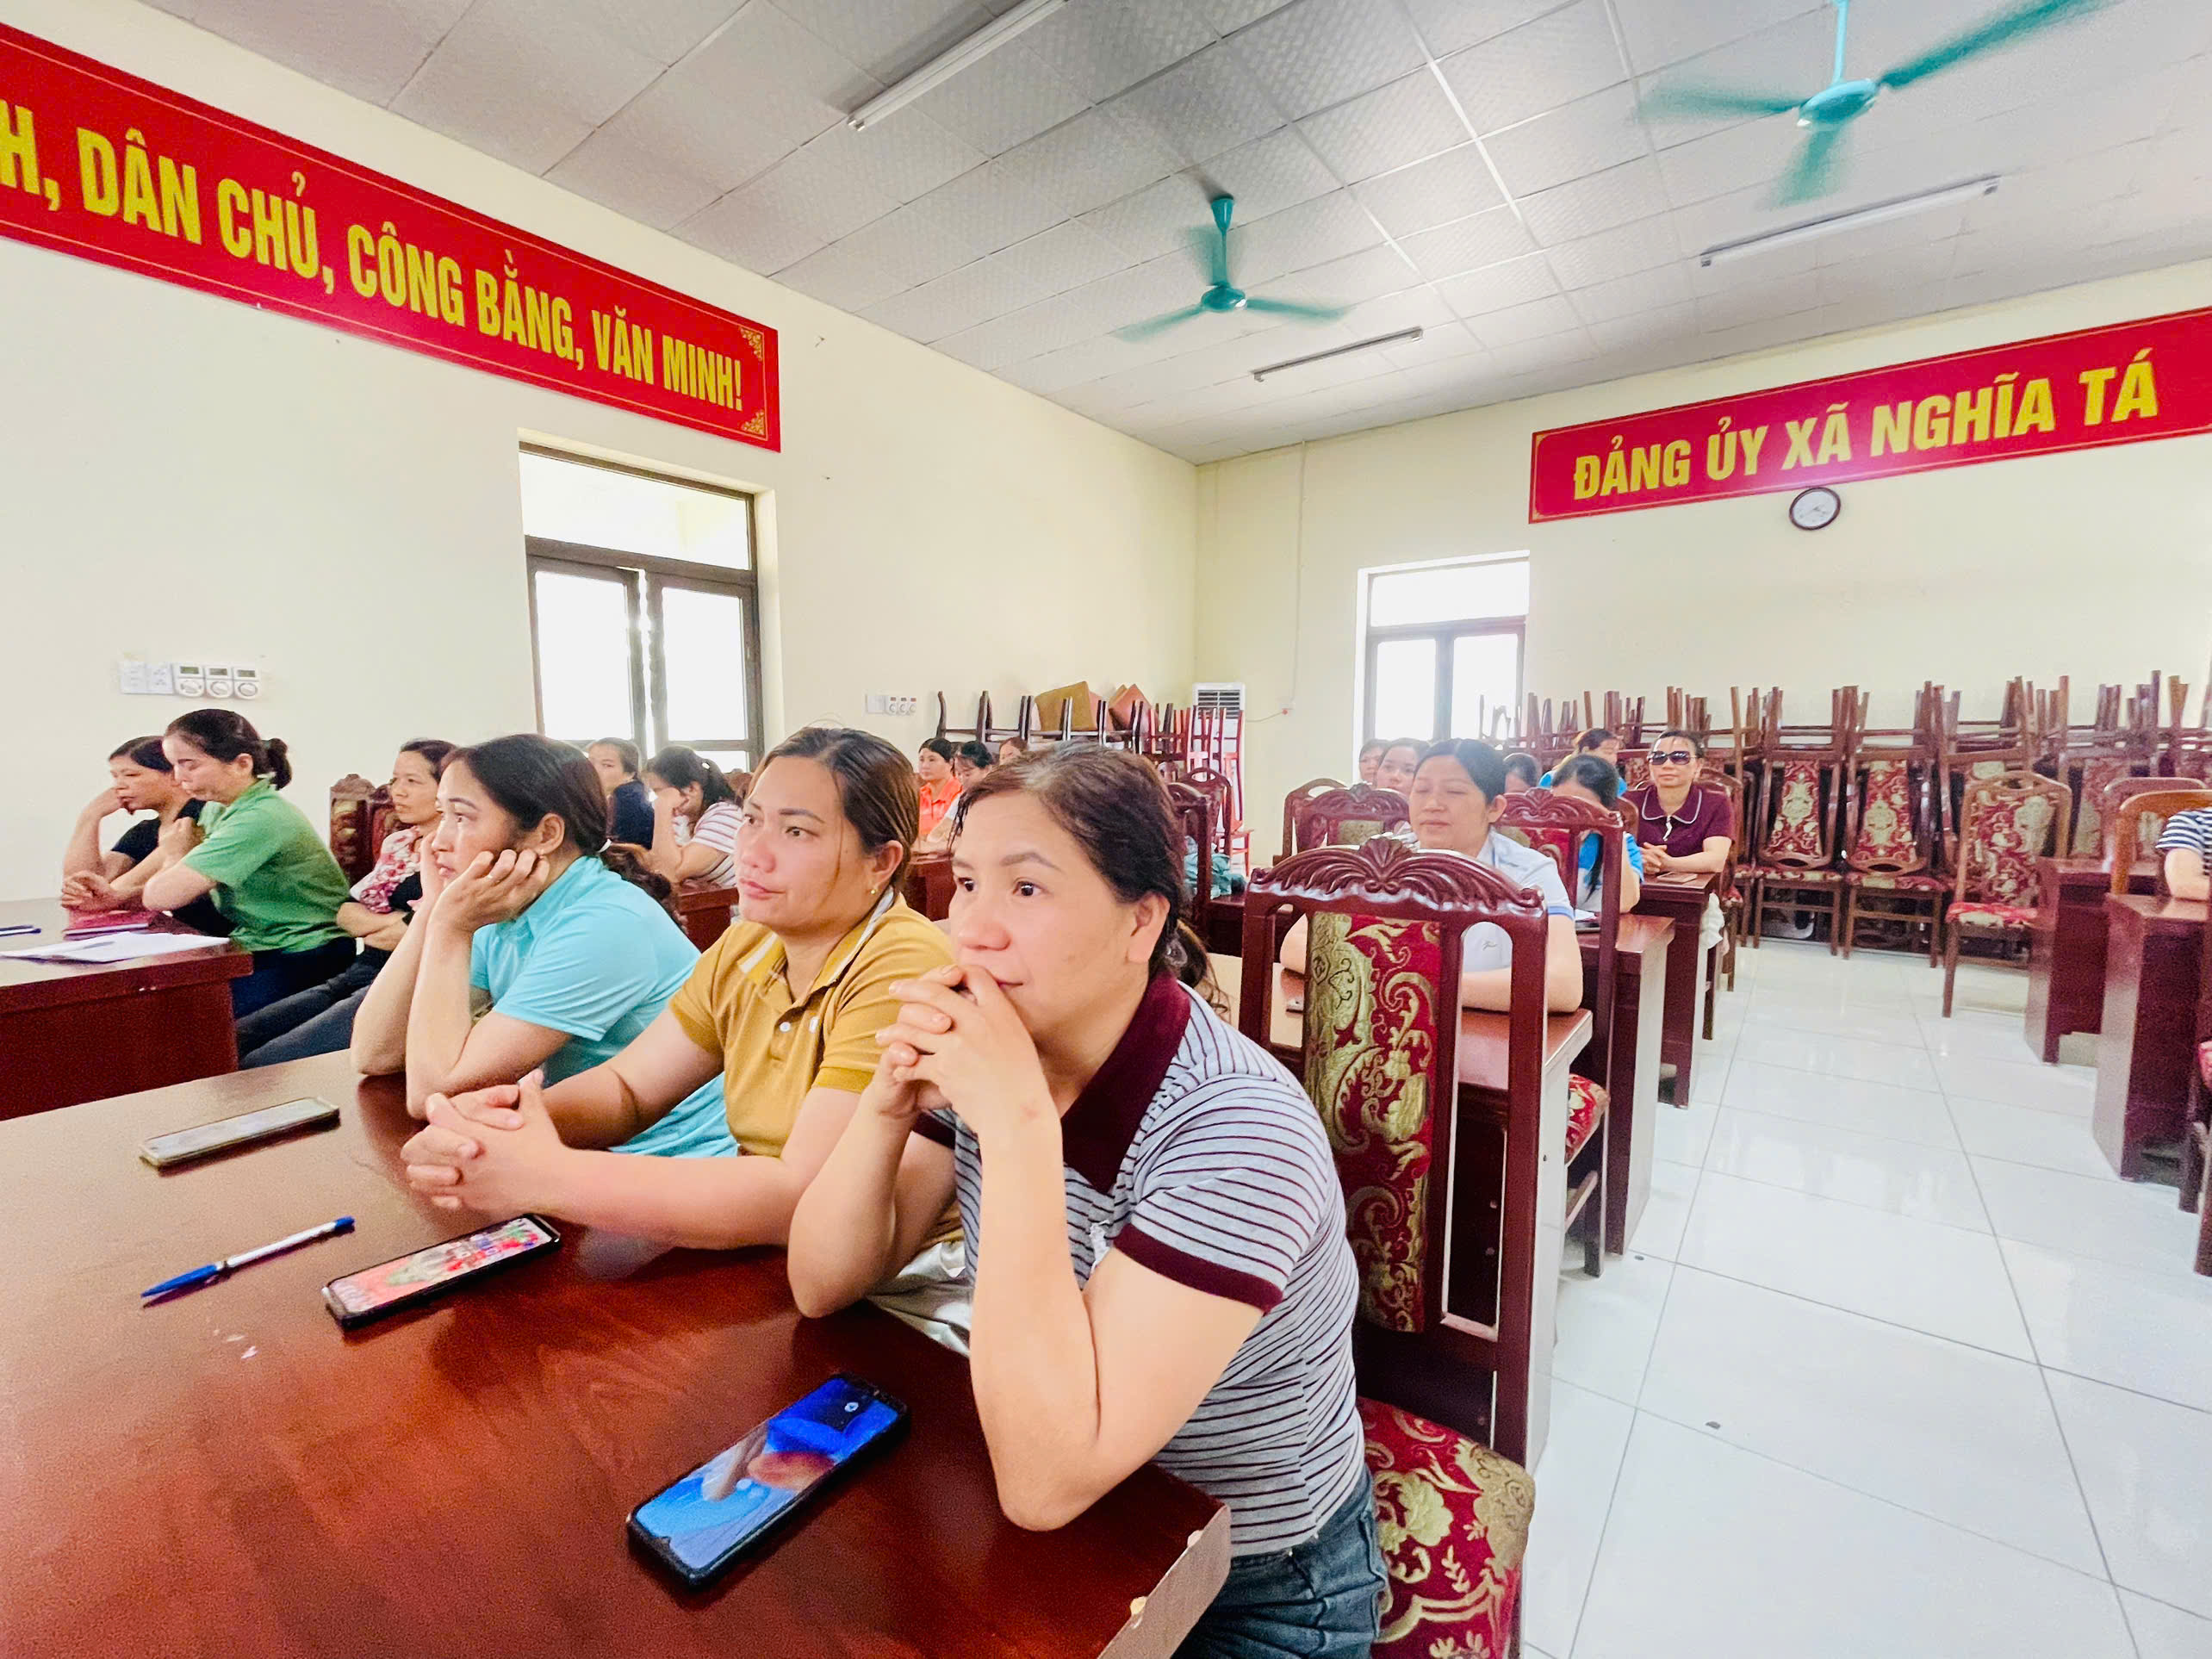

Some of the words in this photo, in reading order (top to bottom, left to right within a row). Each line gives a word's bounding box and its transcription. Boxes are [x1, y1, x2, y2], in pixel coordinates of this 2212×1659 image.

[77, 127, 202, 245] DÂN
[217, 171, 334, 295] CHỦ,
[347, 221, 465, 327] CÔNG
[475, 250, 585, 370] BẰNG,
[591, 305, 655, 385] VĂN
[662, 335, 743, 412] MINH!
[1573, 434, 1692, 500] ĐẢNG
[1706, 416, 1769, 481] ỦY
[1781, 402, 1852, 470] XÃ
[1871, 371, 2056, 457] NGHĨA
[2078, 348, 2160, 426] TÁ
